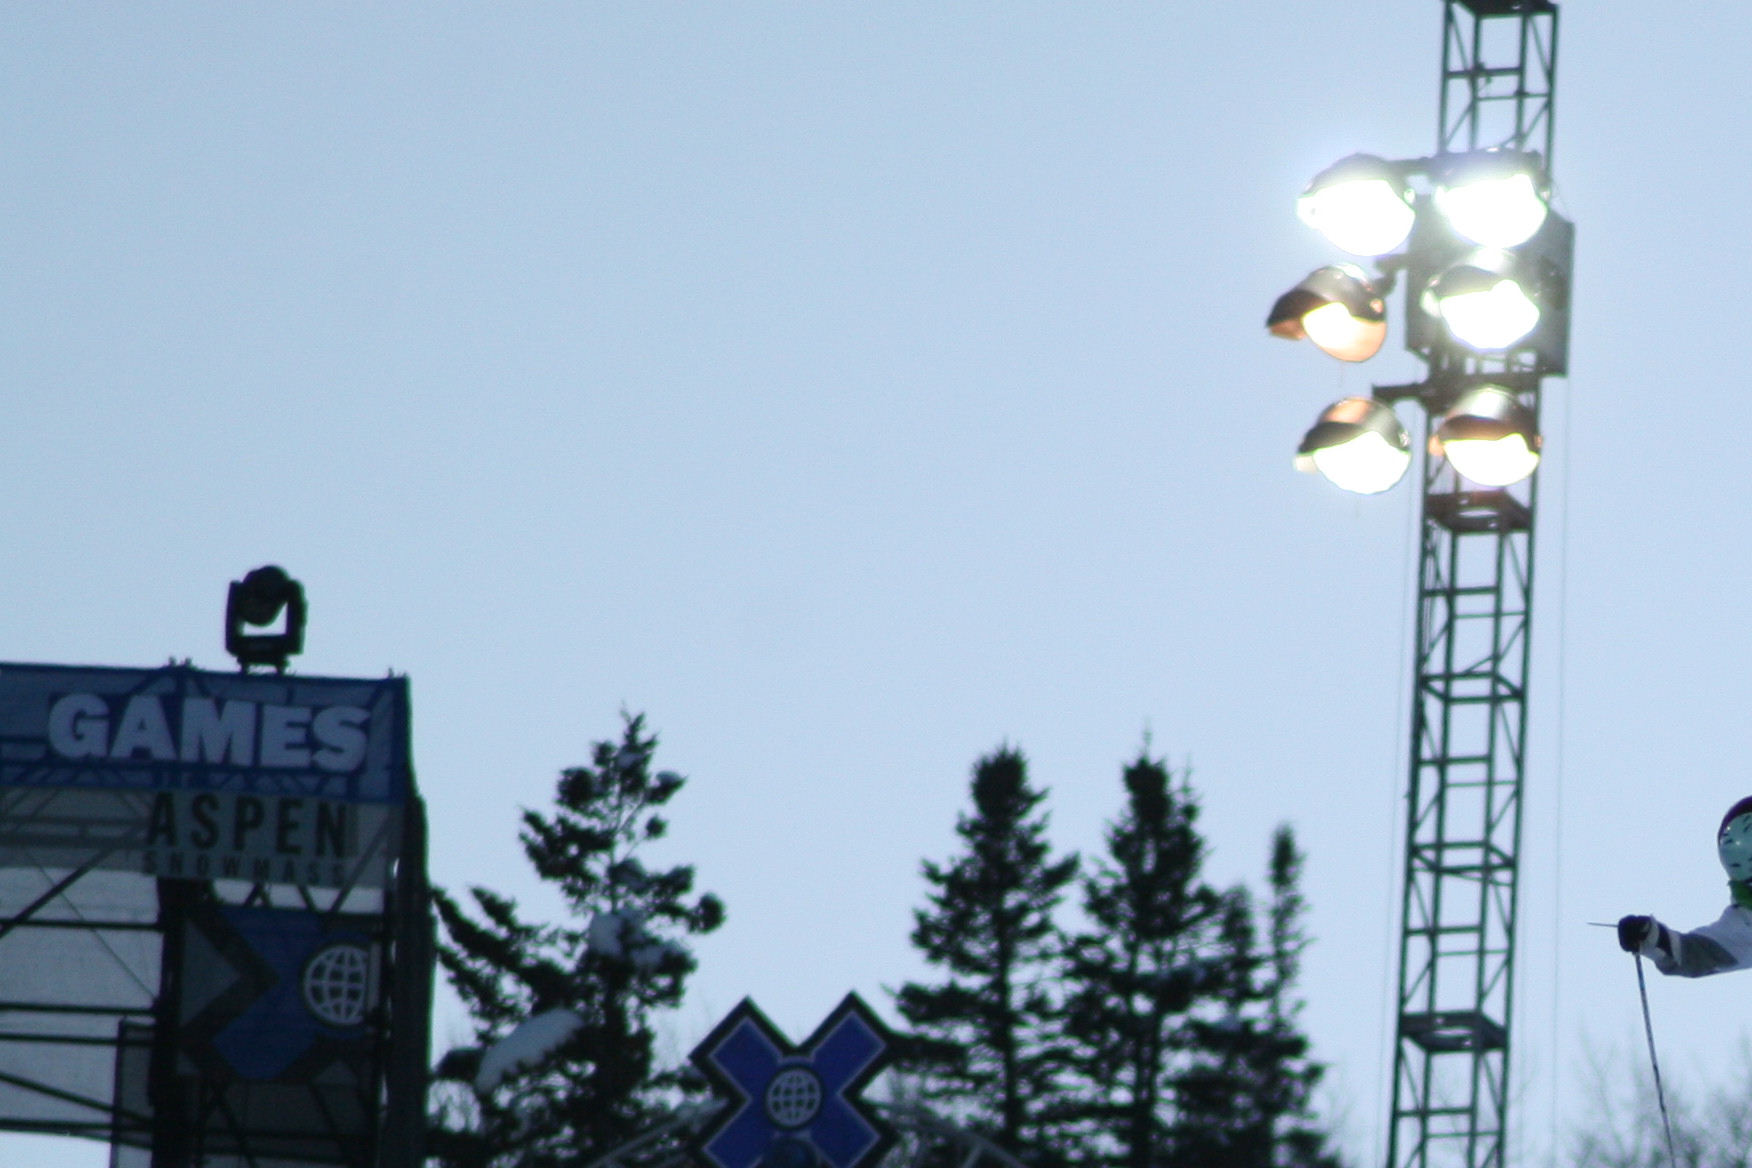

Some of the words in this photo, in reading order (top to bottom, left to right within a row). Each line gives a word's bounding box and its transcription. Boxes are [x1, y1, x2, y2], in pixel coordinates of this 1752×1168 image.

[48, 693, 370, 773] GAMES
[148, 791, 347, 858] ASPEN
[143, 852, 345, 885] SNOWMASS
